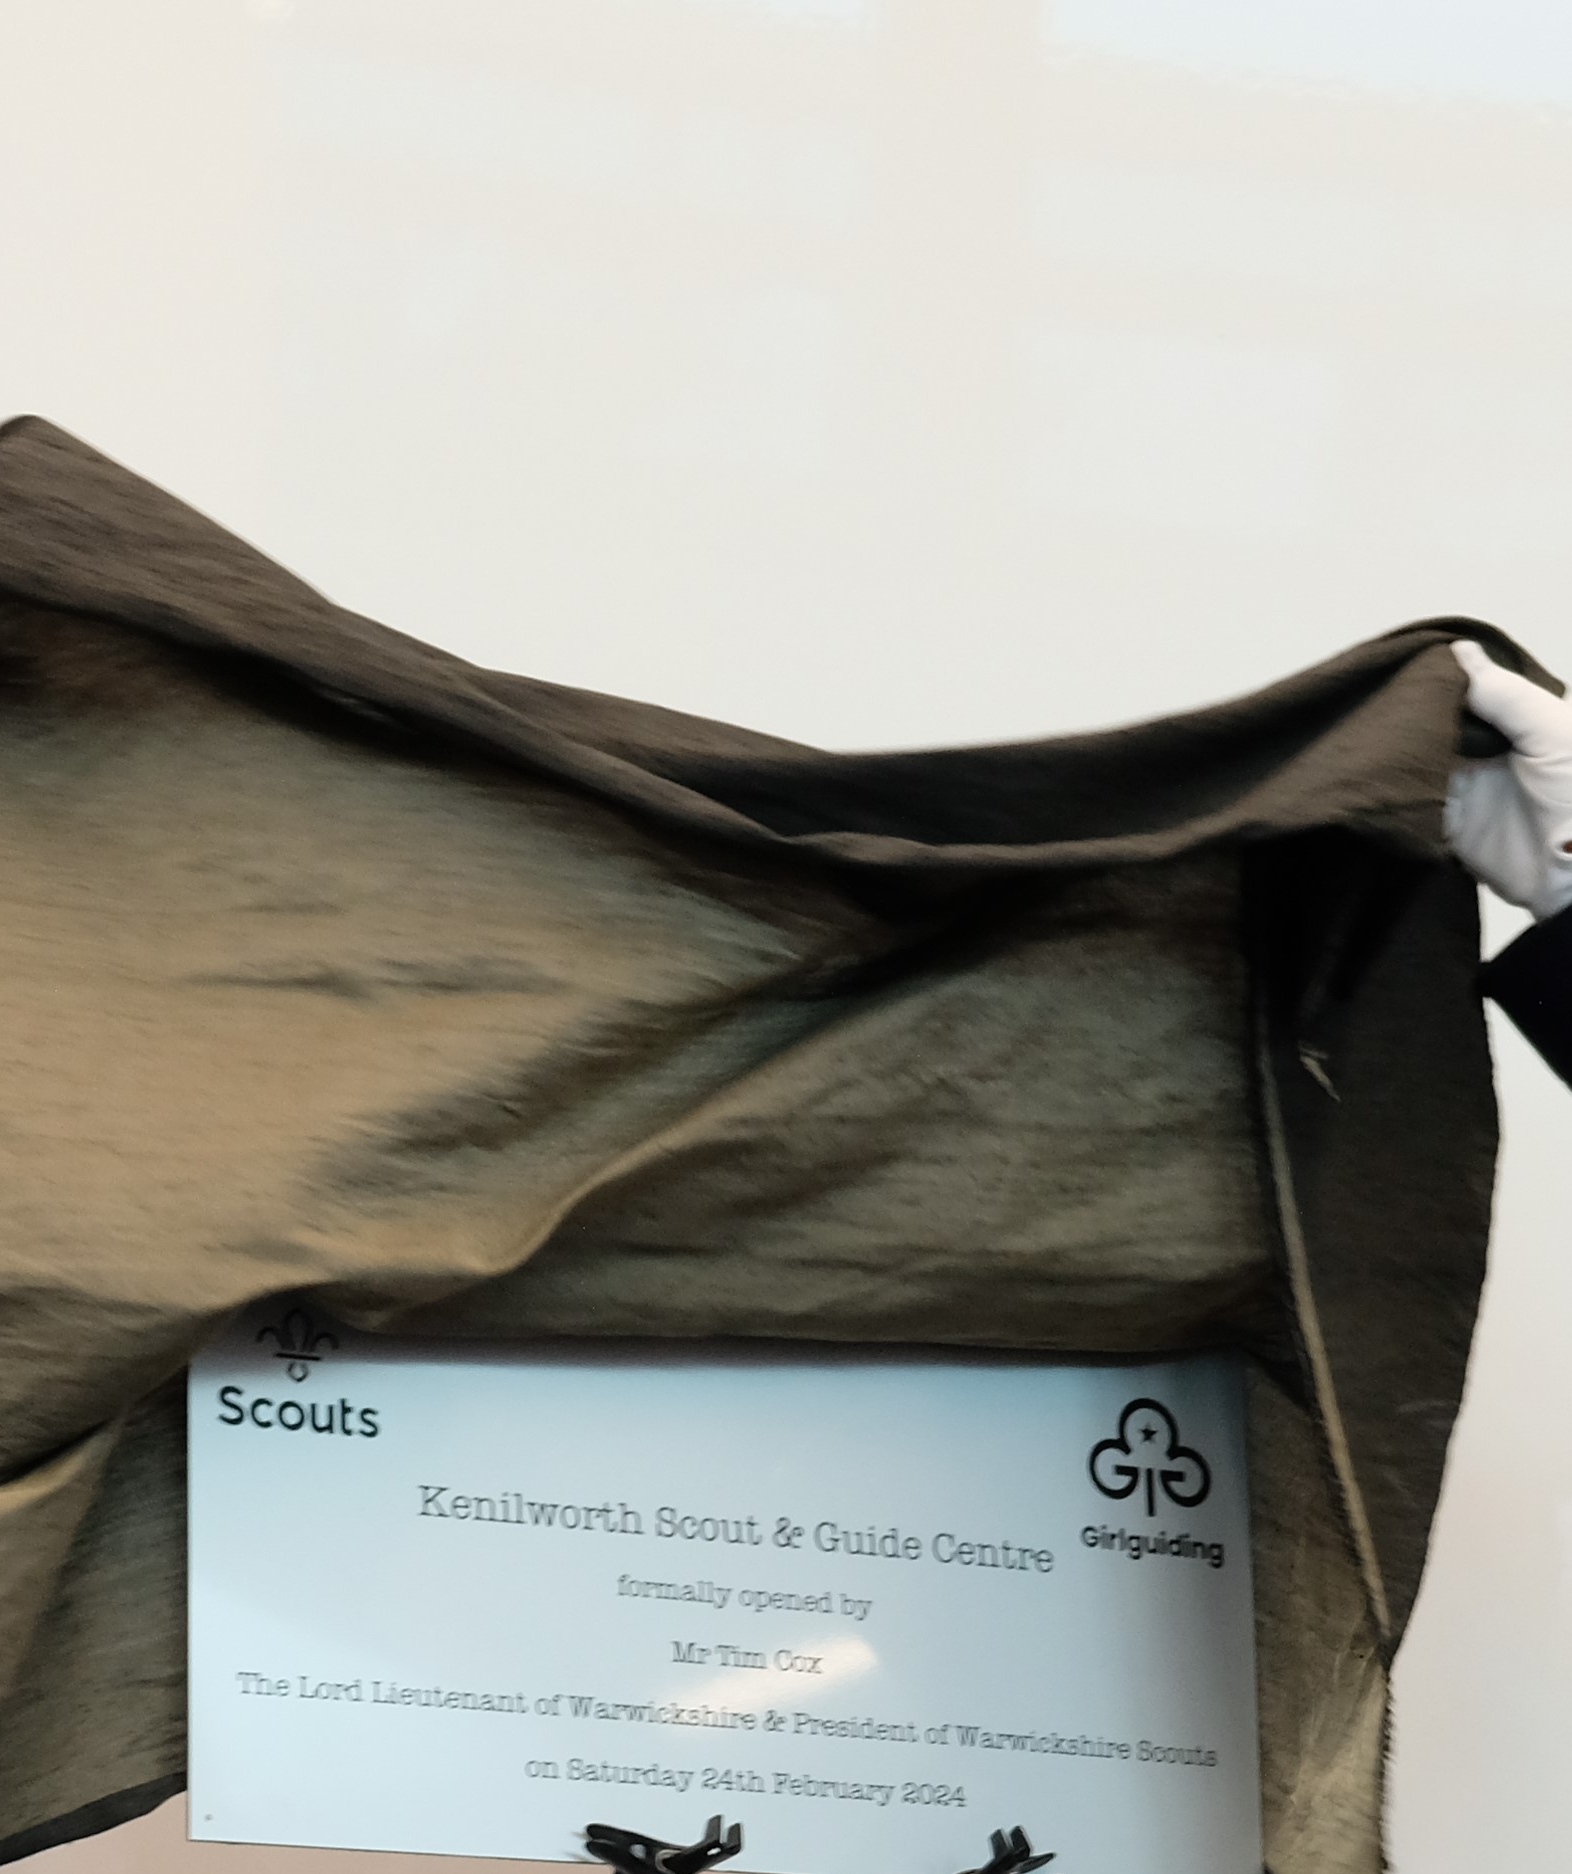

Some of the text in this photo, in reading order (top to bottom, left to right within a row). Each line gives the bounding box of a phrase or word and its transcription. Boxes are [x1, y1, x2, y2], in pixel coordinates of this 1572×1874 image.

[218, 1385, 381, 1438] Scouts
[418, 1485, 1055, 1573] Kenilworth Scout & Guide Centre
[1081, 1524, 1225, 1569] Girlguiding
[617, 1573, 873, 1621] formally opened by
[669, 1640, 824, 1675] Mr Tim Cox
[234, 1671, 1219, 1768] The Lord Lieutenant of Warwickshire & President of Warwickshire Scouts
[524, 1757, 969, 1808] on Saturday 24th February 2024
